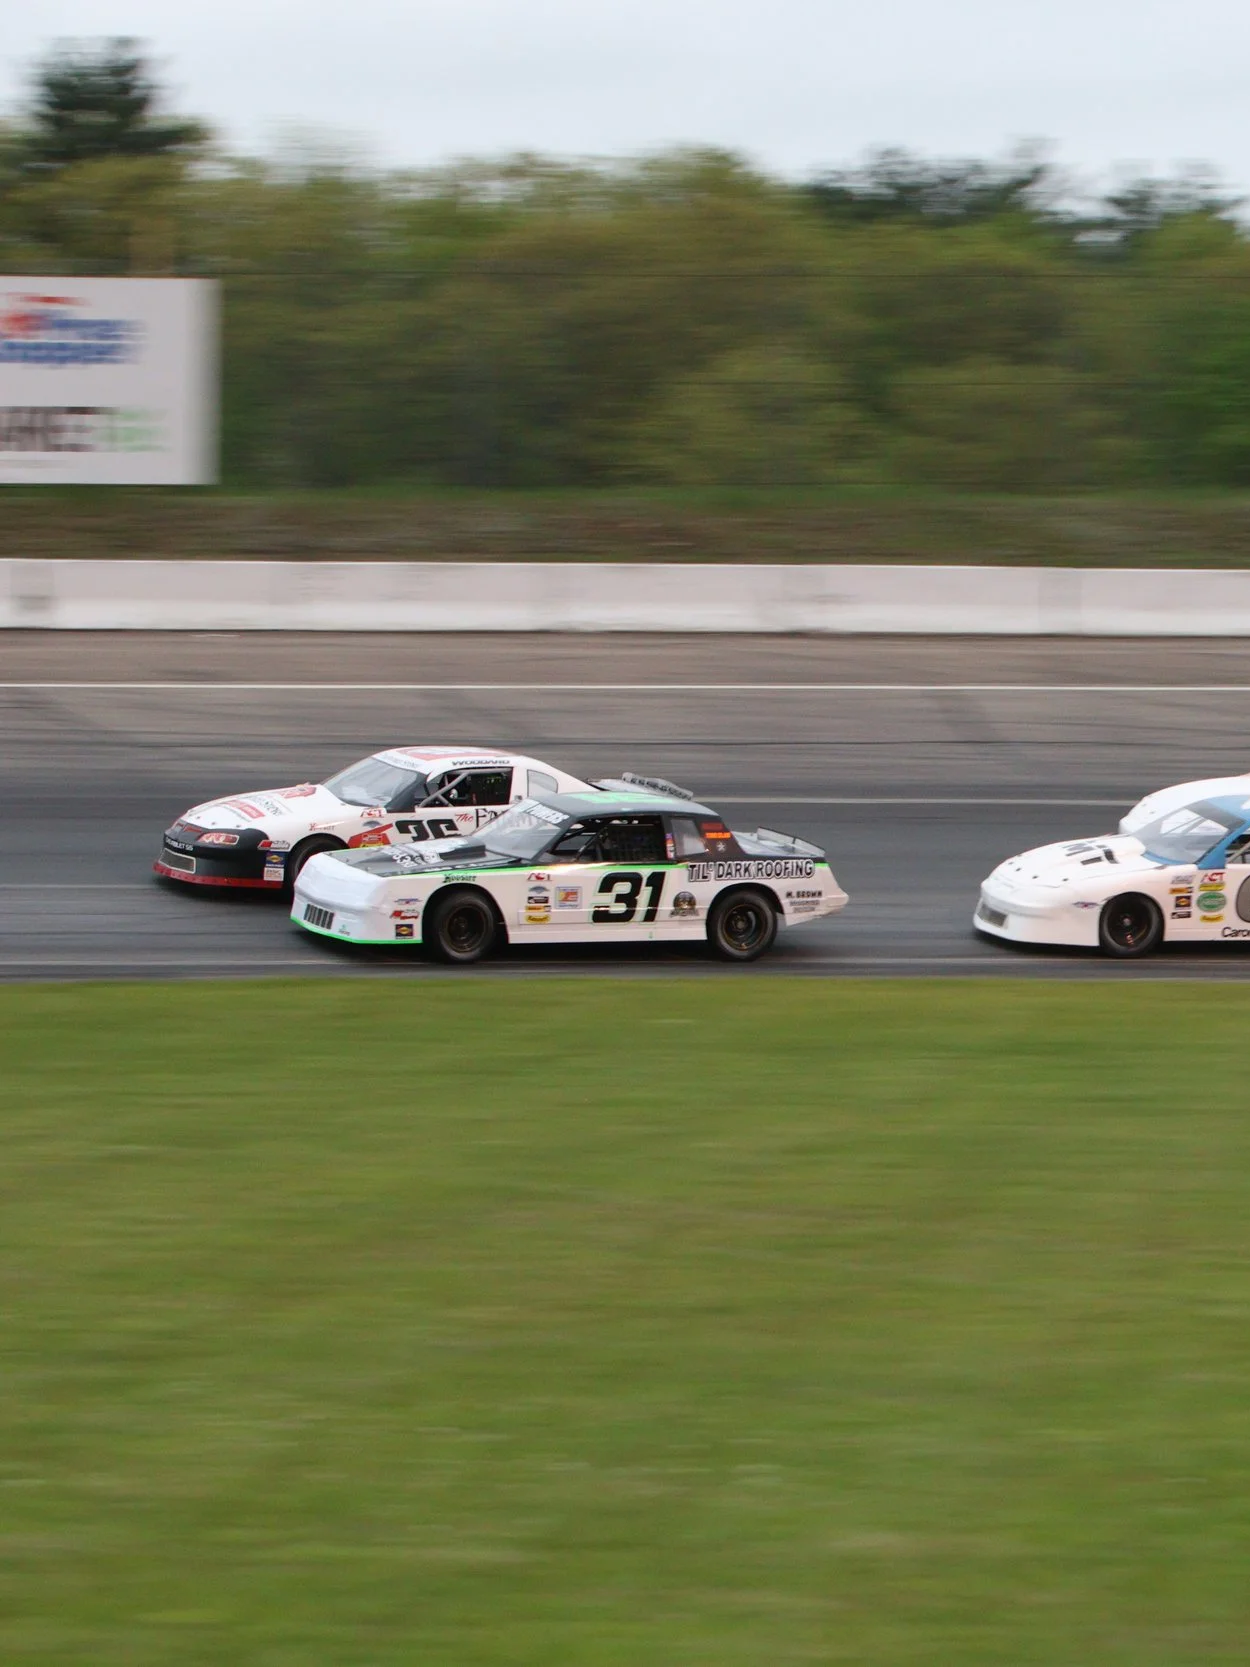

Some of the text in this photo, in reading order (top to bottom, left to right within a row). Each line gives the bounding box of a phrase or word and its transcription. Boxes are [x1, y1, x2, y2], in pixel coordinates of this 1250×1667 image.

[716, 860, 752, 881] DARK
[756, 858, 815, 880] ROOFING
[591, 871, 667, 923] 31
[796, 890, 823, 899] BROWN
